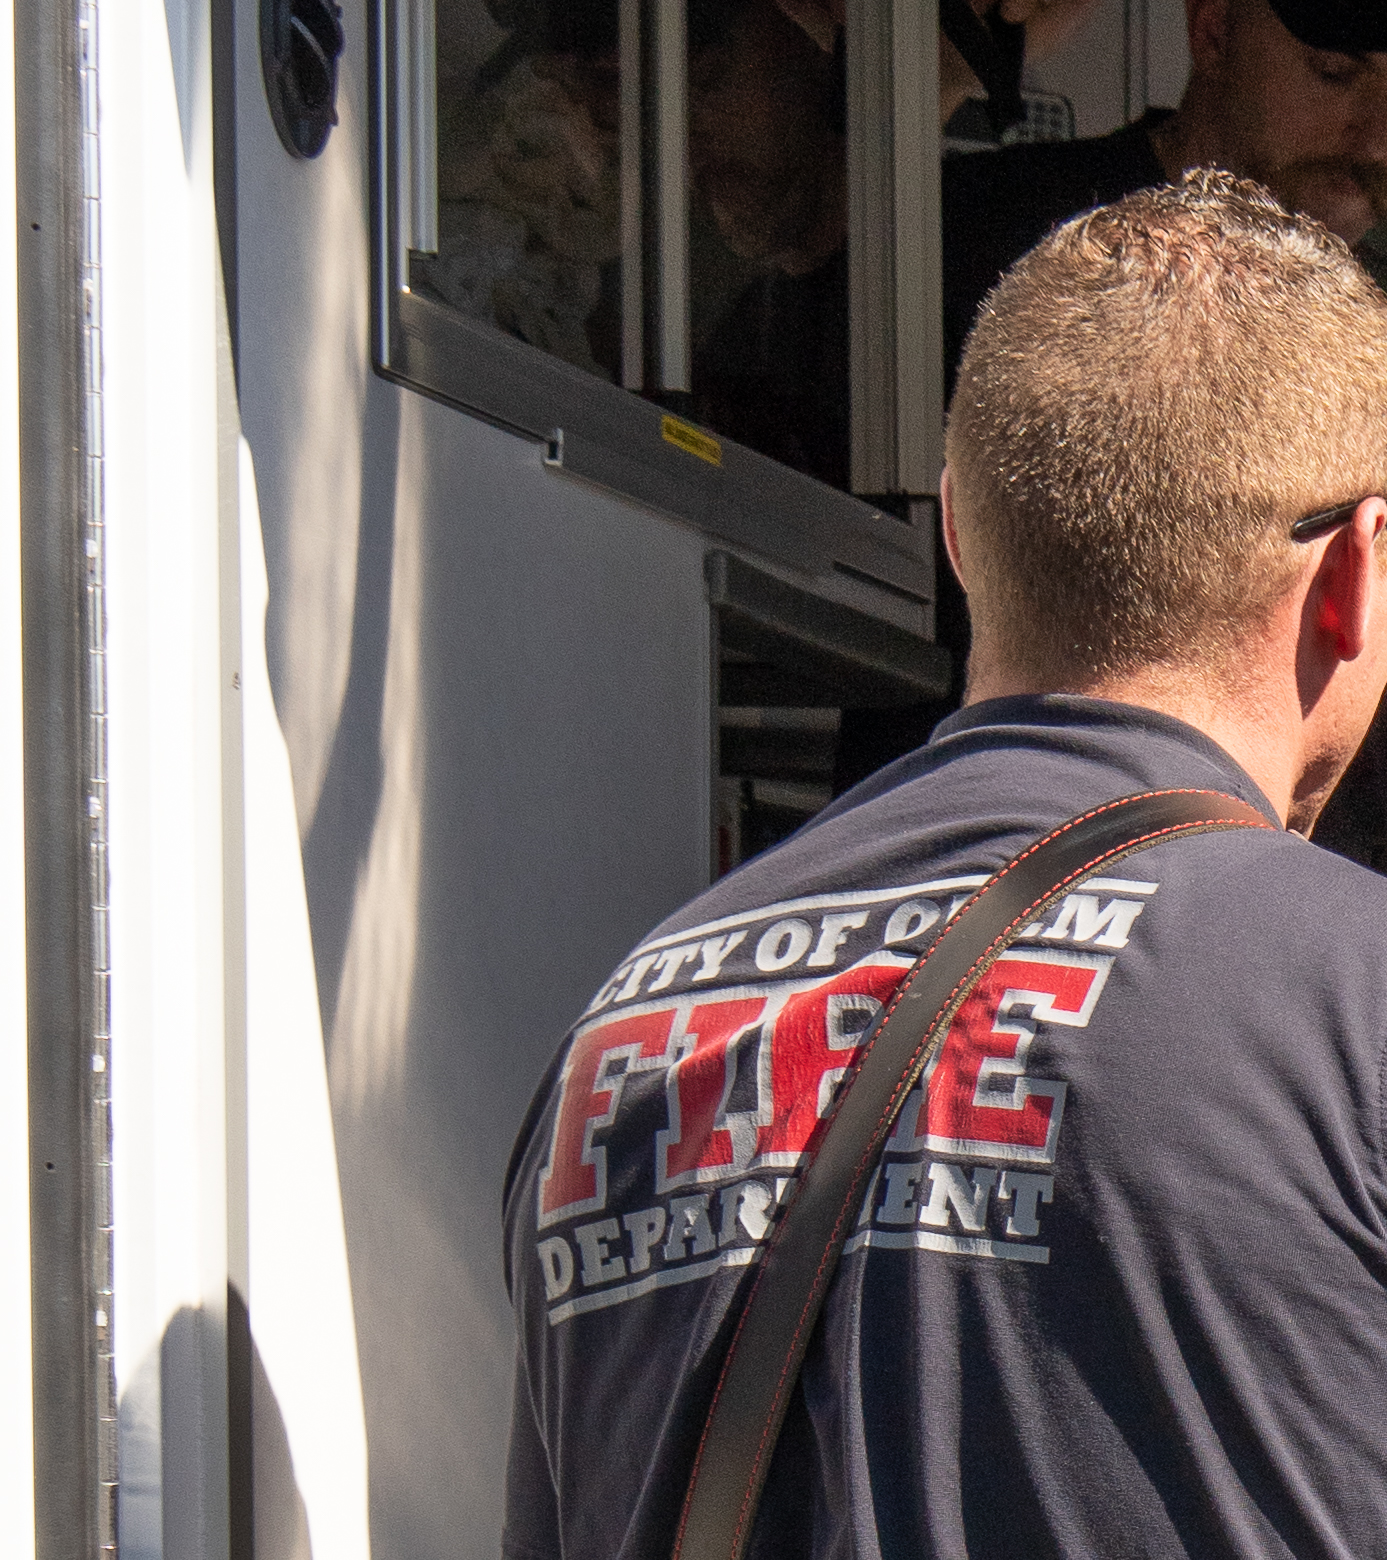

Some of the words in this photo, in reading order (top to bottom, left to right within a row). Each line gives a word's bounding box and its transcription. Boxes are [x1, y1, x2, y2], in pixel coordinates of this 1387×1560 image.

[589, 930, 749, 1011] CITY
[755, 910, 871, 972] OF
[884, 893, 1146, 949] OM
[536, 1160, 1055, 1302] DEPARENT
